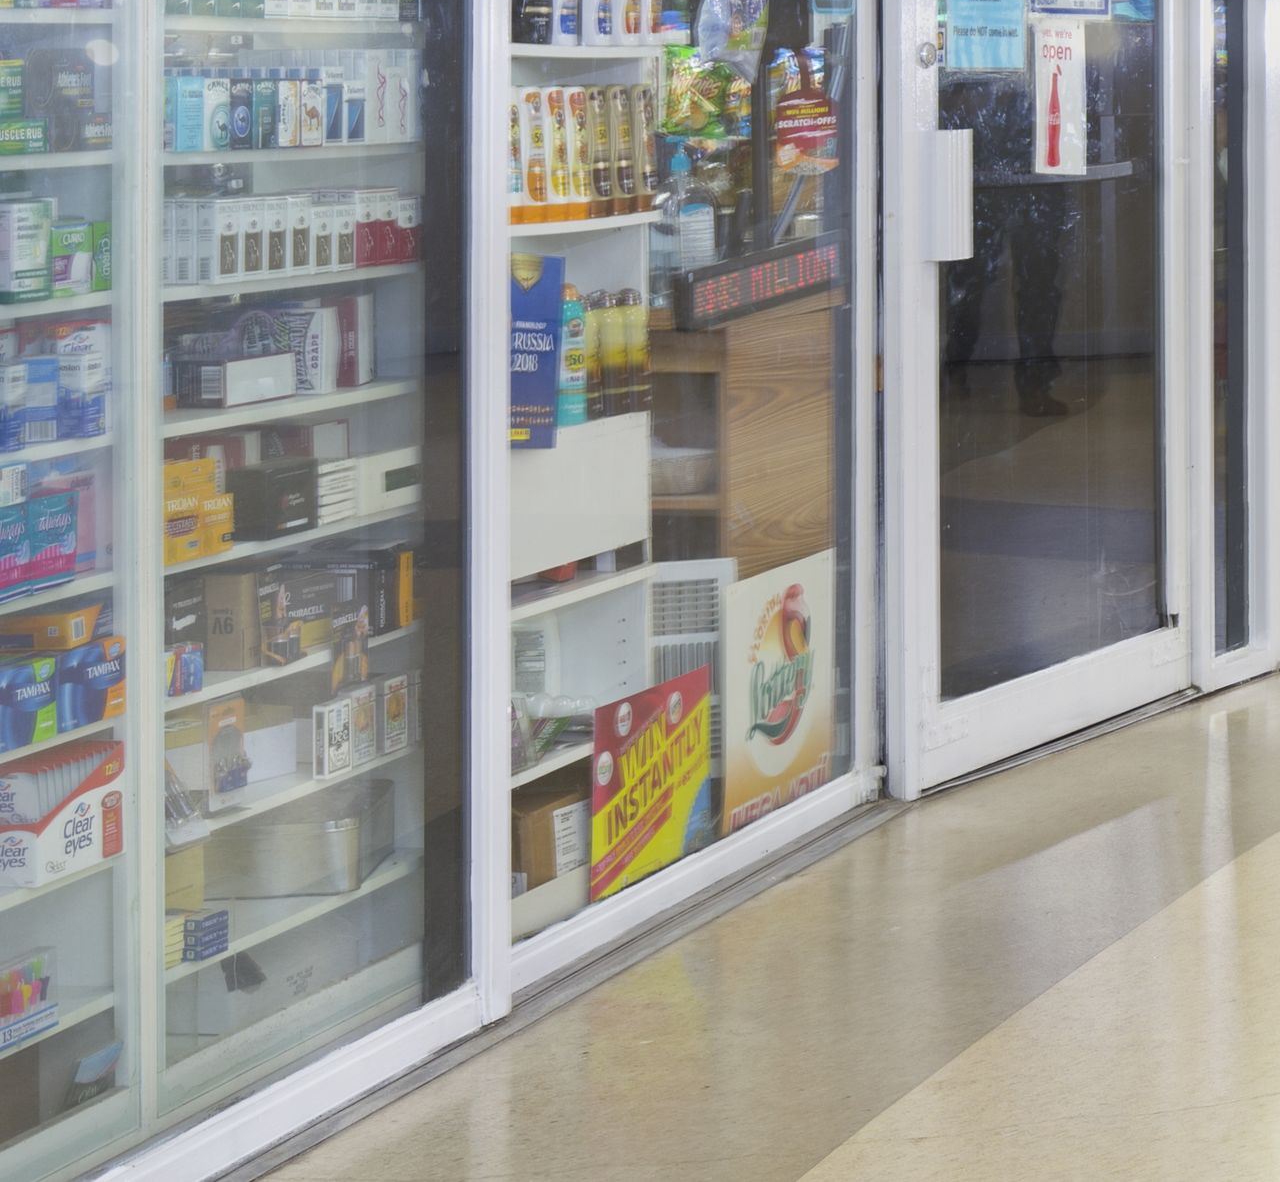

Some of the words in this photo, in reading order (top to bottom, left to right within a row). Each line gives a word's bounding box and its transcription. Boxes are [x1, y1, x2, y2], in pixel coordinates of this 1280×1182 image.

[1042, 44, 1073, 62] open
[310, 332, 319, 369] GRAPE
[86, 658, 121, 680] TAMPAX
[15, 680, 51, 702] TAMPAX
[606, 706, 704, 847] INSTANTLY
[64, 814, 95, 839] Clear
[65, 832, 93, 858] eyes
